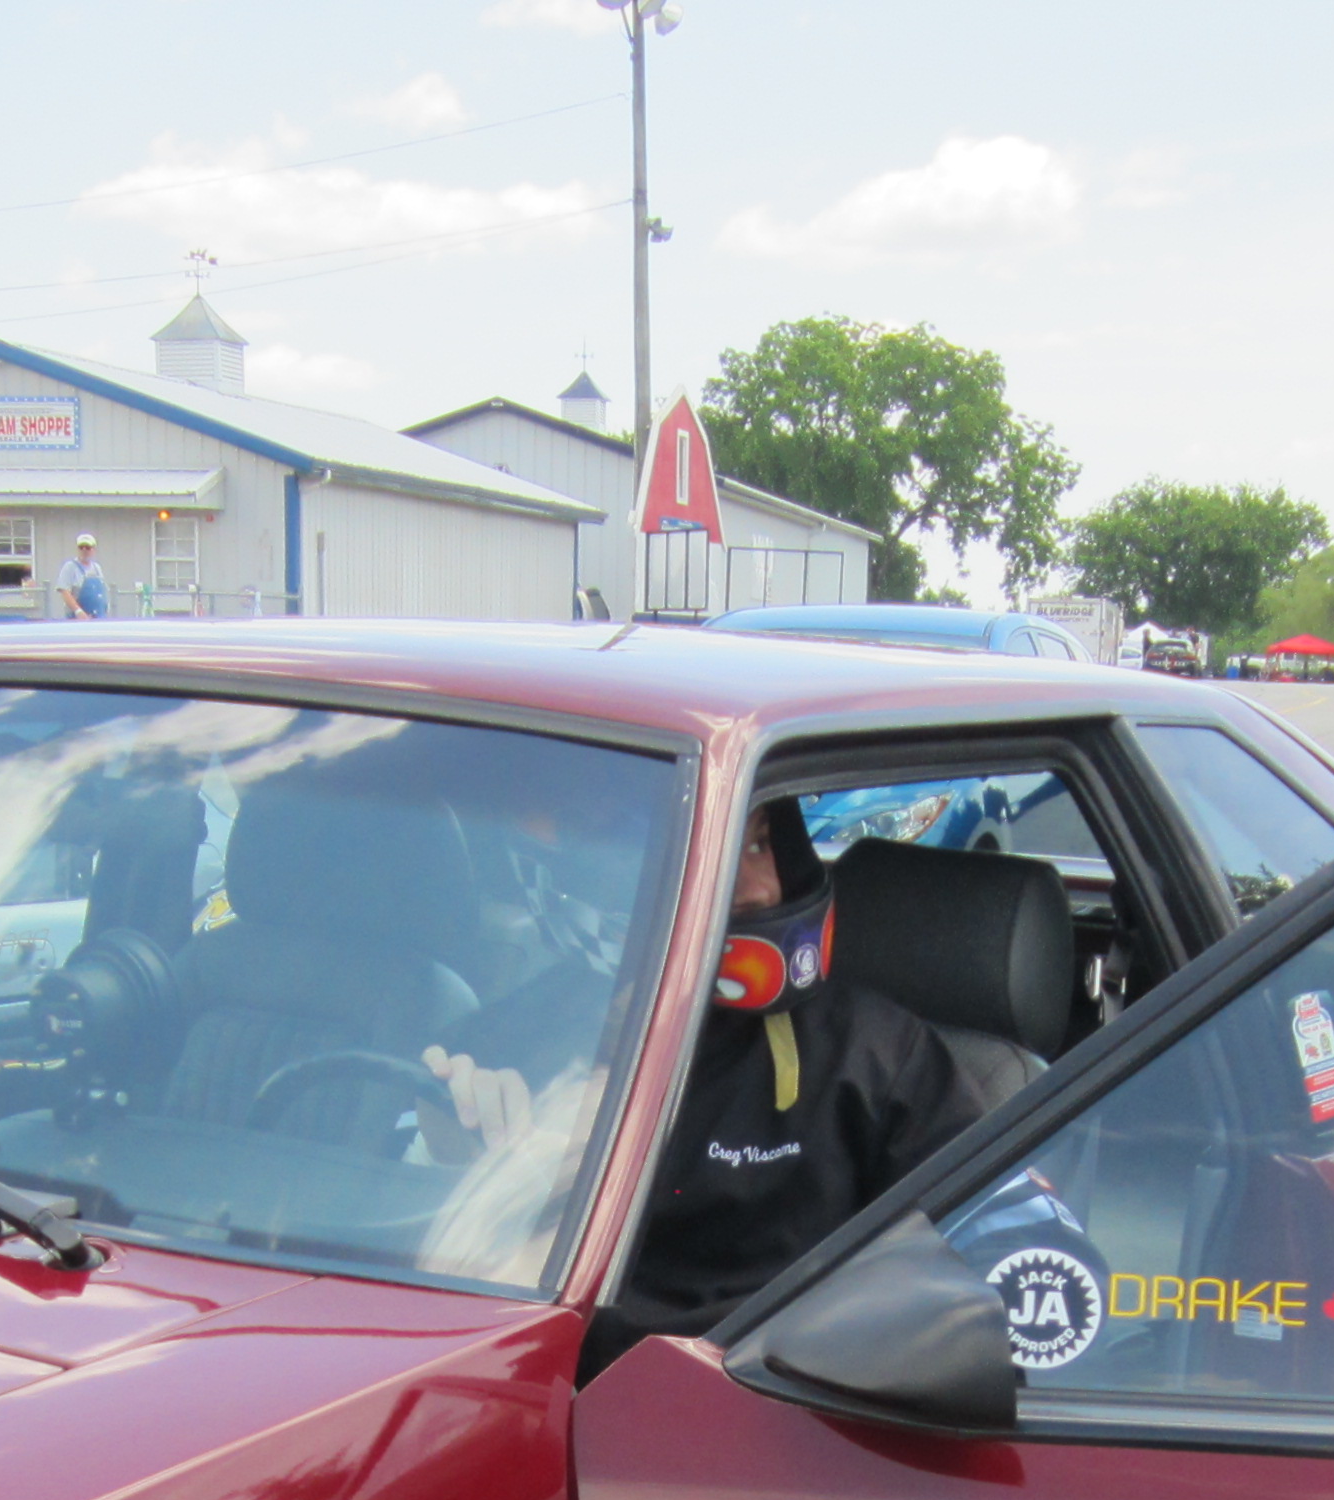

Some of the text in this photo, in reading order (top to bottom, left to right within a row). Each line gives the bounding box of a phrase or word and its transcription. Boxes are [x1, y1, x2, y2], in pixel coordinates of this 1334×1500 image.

[20, 416, 72, 436] SHOPPE
[708, 1141, 802, 1169] Greg Viscome
[1018, 1271, 1068, 1291] JACK
[1008, 1290, 1071, 1327] JA
[1107, 1273, 1308, 1327] DRAKE
